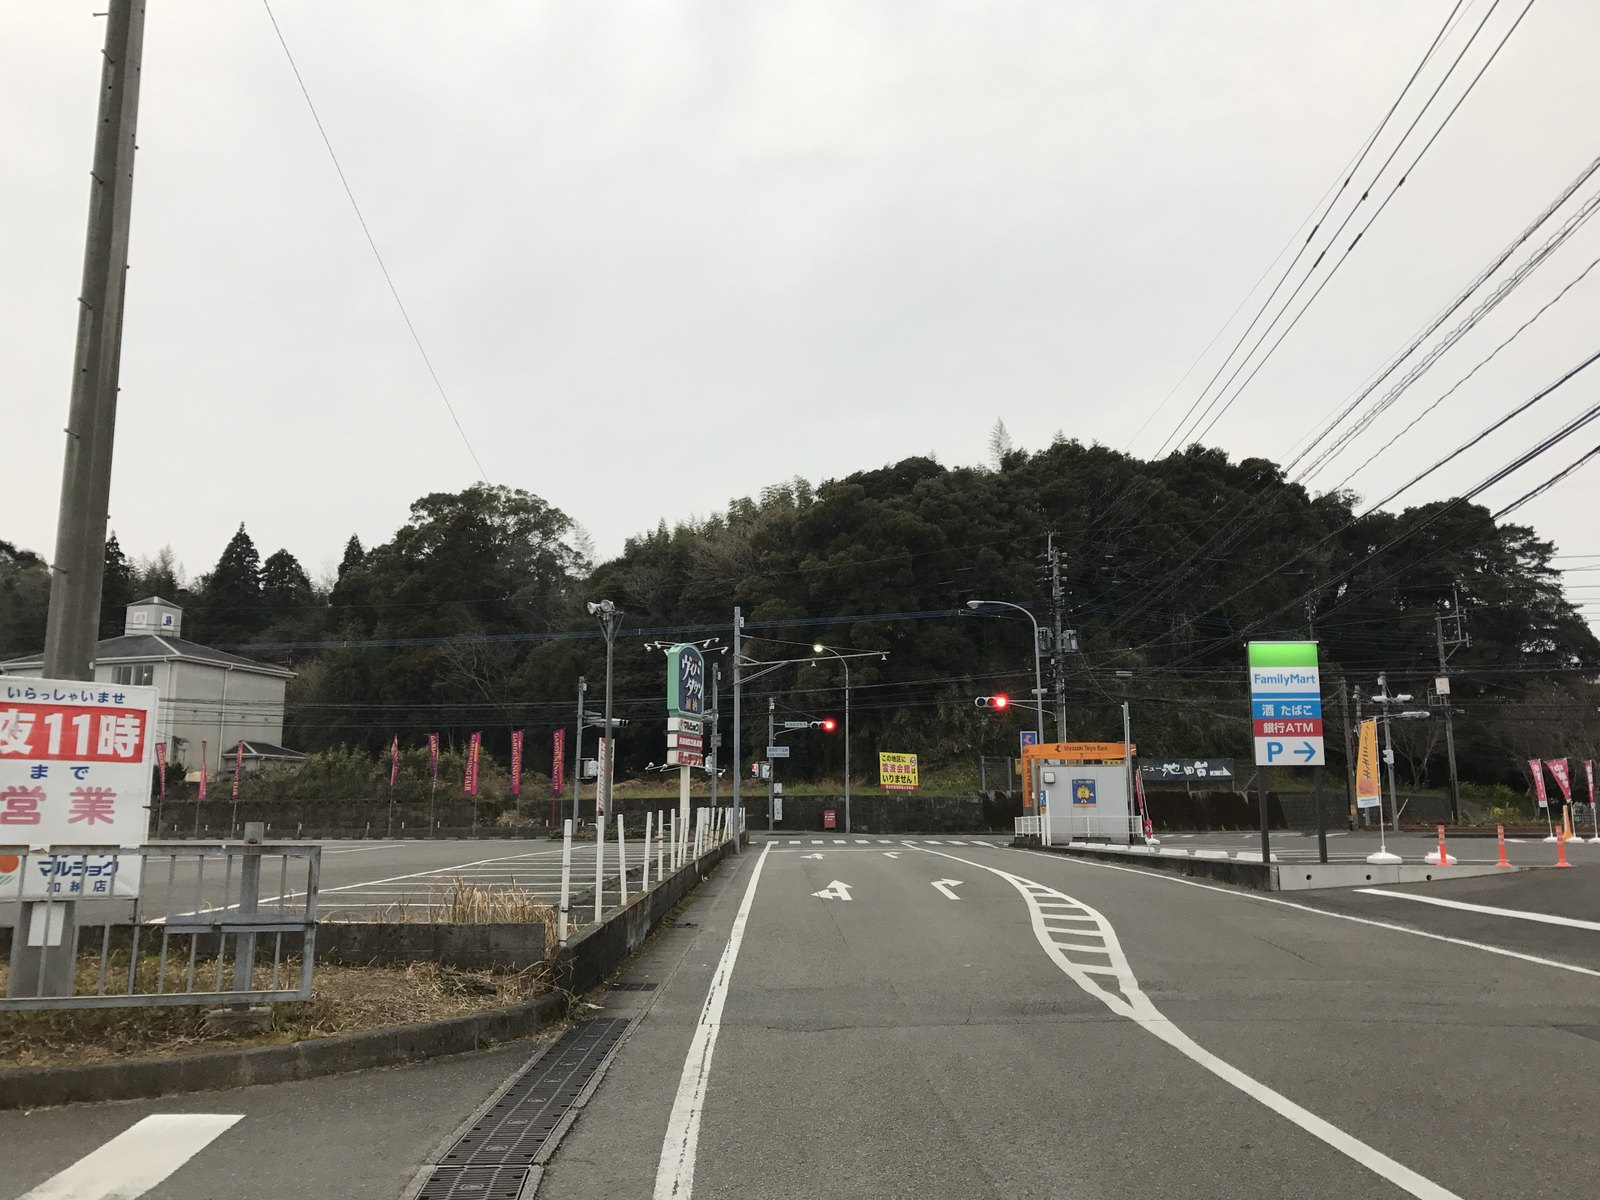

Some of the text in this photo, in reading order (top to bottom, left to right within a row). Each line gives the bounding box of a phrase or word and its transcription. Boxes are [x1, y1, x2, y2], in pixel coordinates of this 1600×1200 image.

[1254, 674, 1316, 686] FamilyMart
[8, 687, 126, 704] いらっしゃいませ
[1262, 704, 1313, 716] 酒 たばこ
[0, 708, 141, 758] 夜11時
[1263, 722, 1314, 734] 銀行ATM
[1267, 742, 1283, 762] P
[30, 764, 90, 780] まで
[0, 785, 118, 826] 営業
